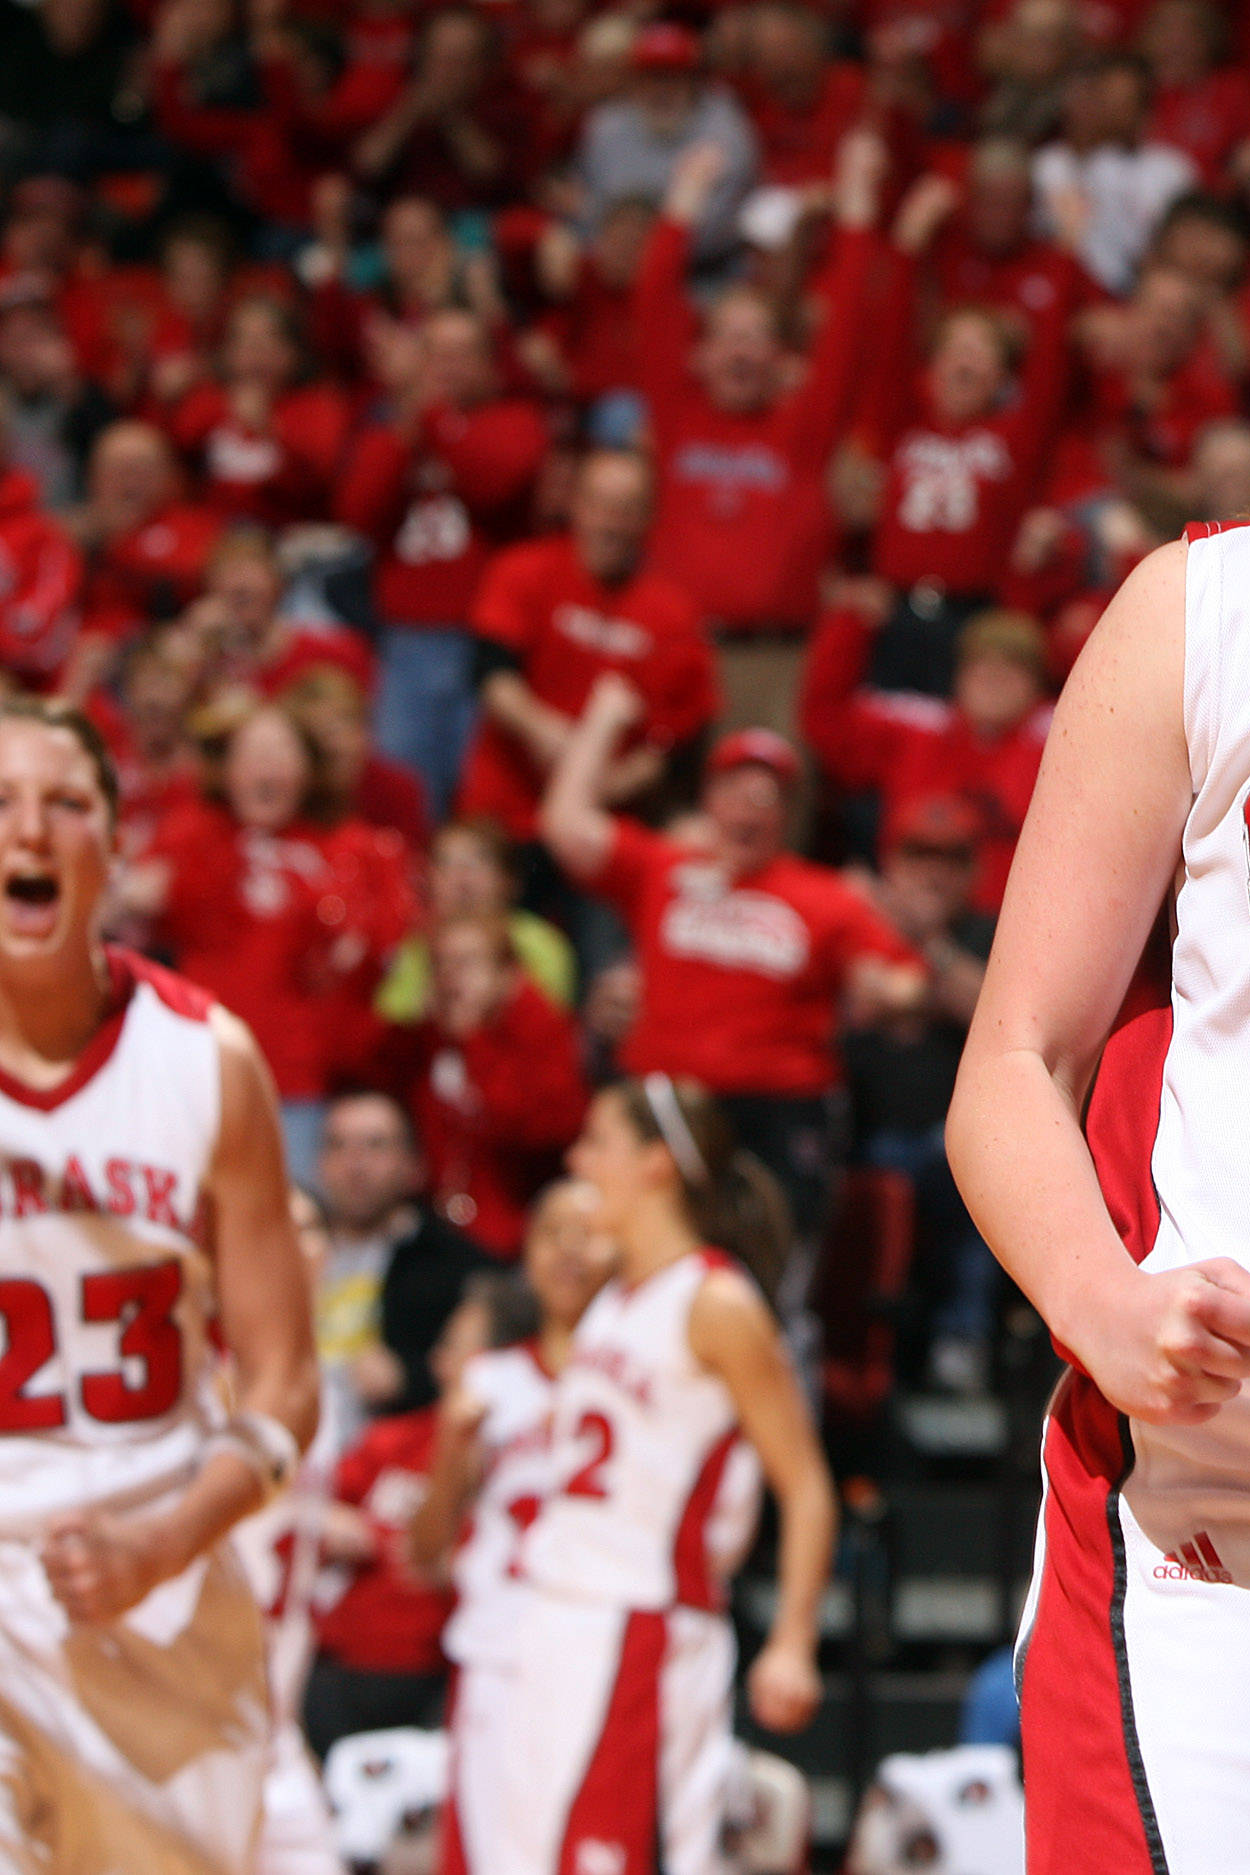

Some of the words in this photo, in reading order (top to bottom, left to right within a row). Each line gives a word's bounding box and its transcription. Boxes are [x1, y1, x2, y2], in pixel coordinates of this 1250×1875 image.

[0, 1258, 182, 1432] 23
[564, 1407, 616, 1503] 2
[1152, 1565, 1233, 1585] adidas
